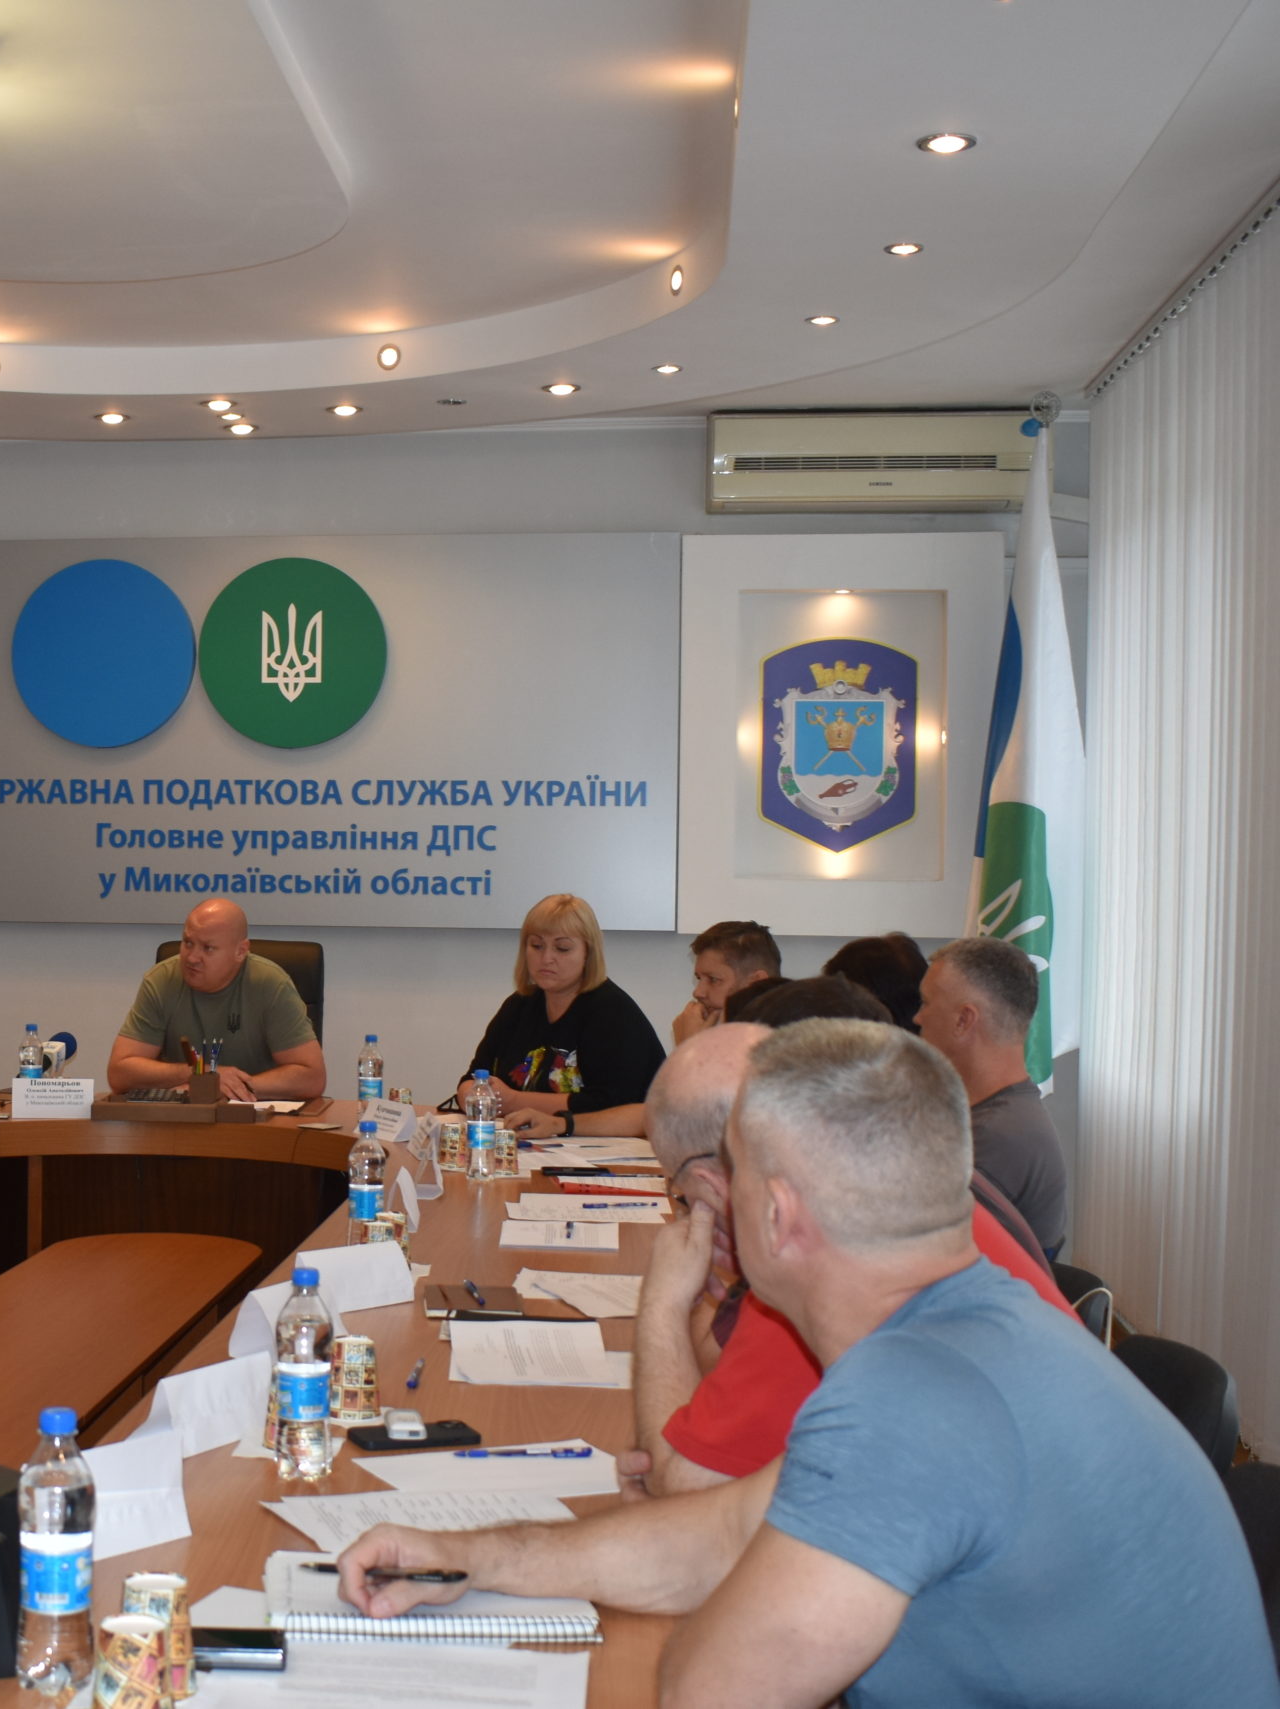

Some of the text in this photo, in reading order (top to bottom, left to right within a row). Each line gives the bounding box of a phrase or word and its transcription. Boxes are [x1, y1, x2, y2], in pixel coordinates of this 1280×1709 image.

[143, 779, 343, 809] ПОДАТКОВА
[352, 779, 493, 807] СЛУЖБА
[503, 775, 649, 807] УКРАЇНИ
[96, 823, 497, 856] Головне управління ДПС
[99, 867, 492, 898] у Миколаївській області
